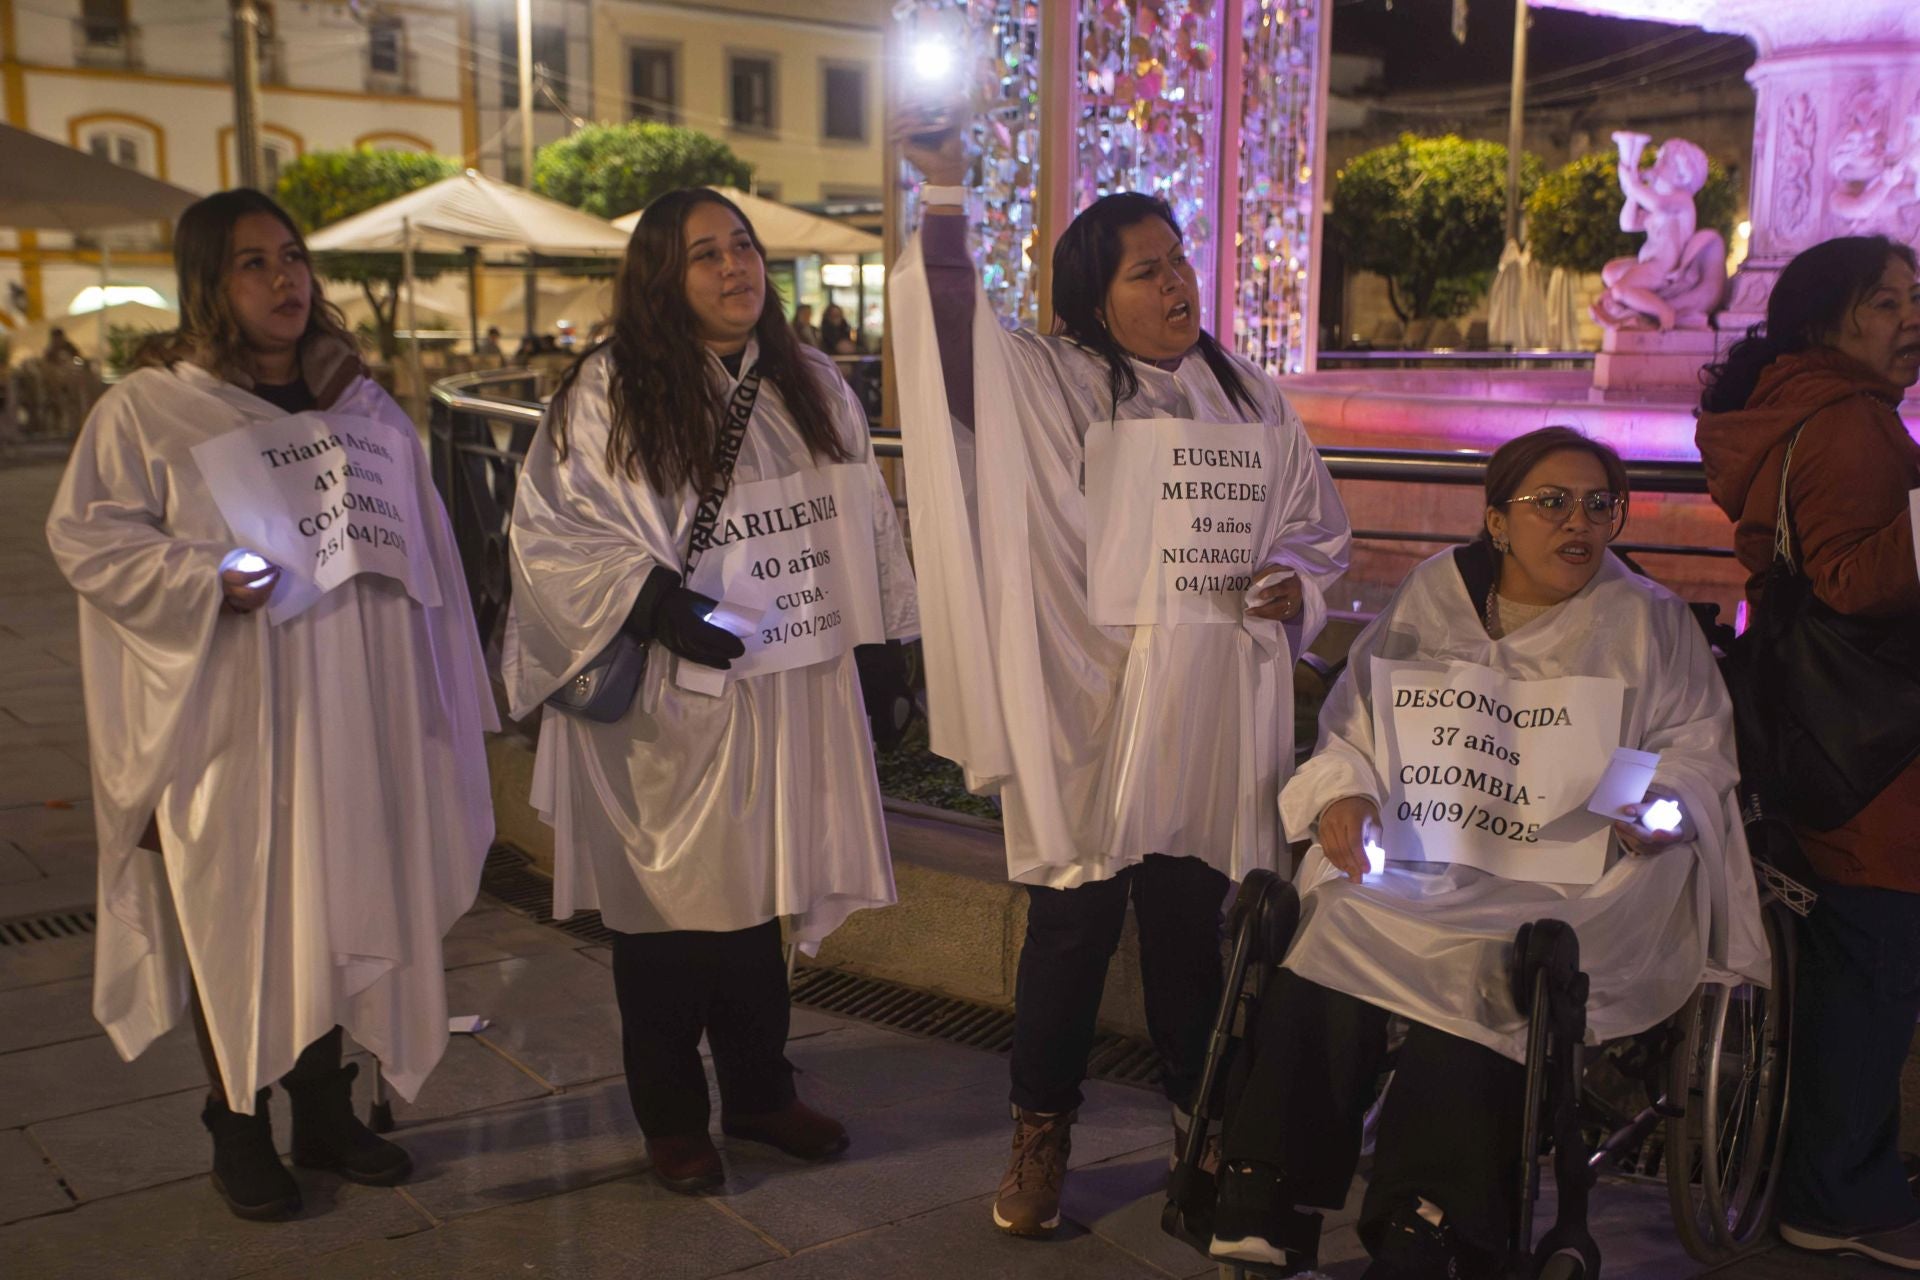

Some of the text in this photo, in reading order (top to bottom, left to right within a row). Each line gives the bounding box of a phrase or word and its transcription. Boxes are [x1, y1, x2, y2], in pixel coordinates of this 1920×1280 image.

[261, 433, 344, 469] Triana
[1173, 448, 1262, 469] EUGENIA
[314, 461, 384, 492] 41 años
[1161, 482, 1267, 502] MERCEDES
[298, 492, 403, 538] COLOMBIA
[702, 494, 838, 550] KARILENIA
[1191, 517, 1252, 534] 49 años
[751, 548, 831, 580] 40 años
[1162, 548, 1255, 564] NICARAGU
[1175, 576, 1252, 595] 04/11/202
[1394, 688, 1573, 729] DESCONOCIDA
[1431, 726, 1521, 766] 37 años
[1399, 765, 1531, 806] COLOMBIA
[1397, 800, 1541, 843] 04/09/2025
